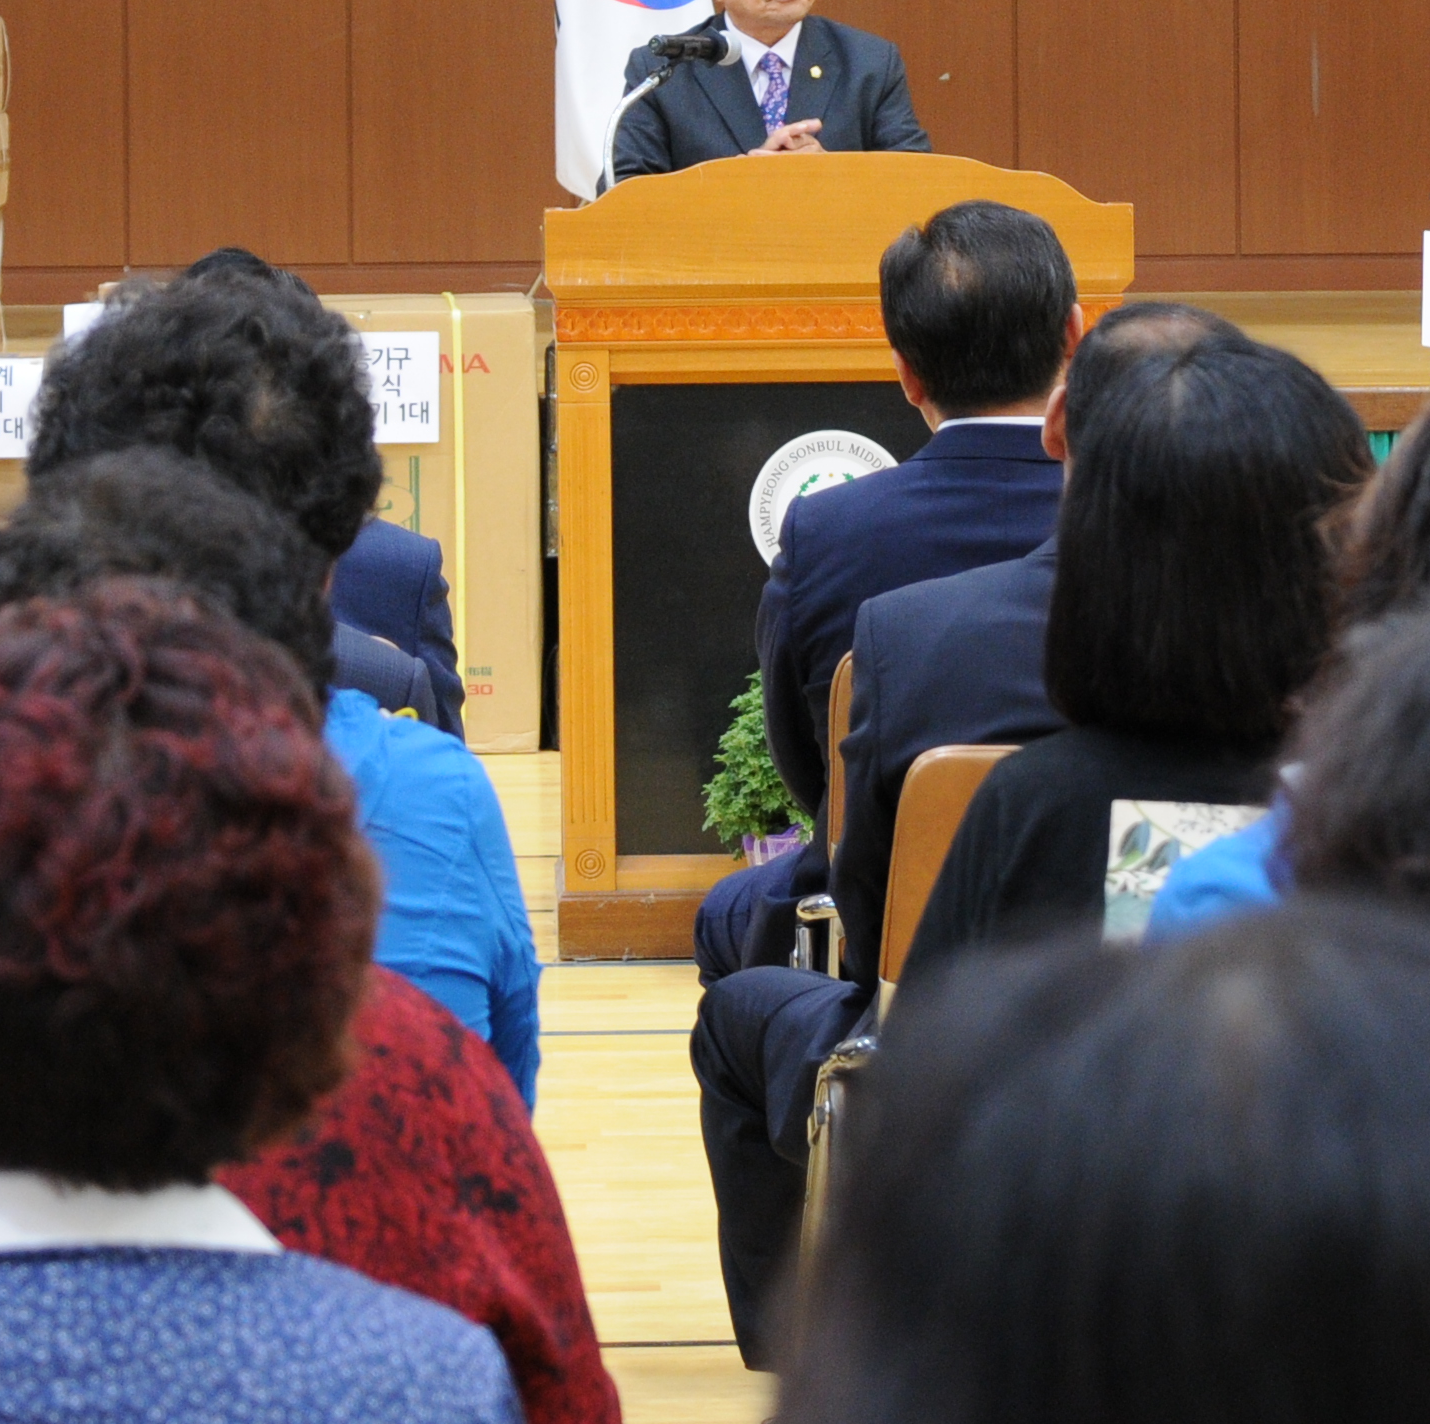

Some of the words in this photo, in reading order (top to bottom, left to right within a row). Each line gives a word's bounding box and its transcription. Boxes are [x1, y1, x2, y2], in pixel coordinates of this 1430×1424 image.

[398, 400, 430, 424] 1대
[759, 460, 790, 549] HAMPYEONG
[788, 440, 845, 464] SONBUL
